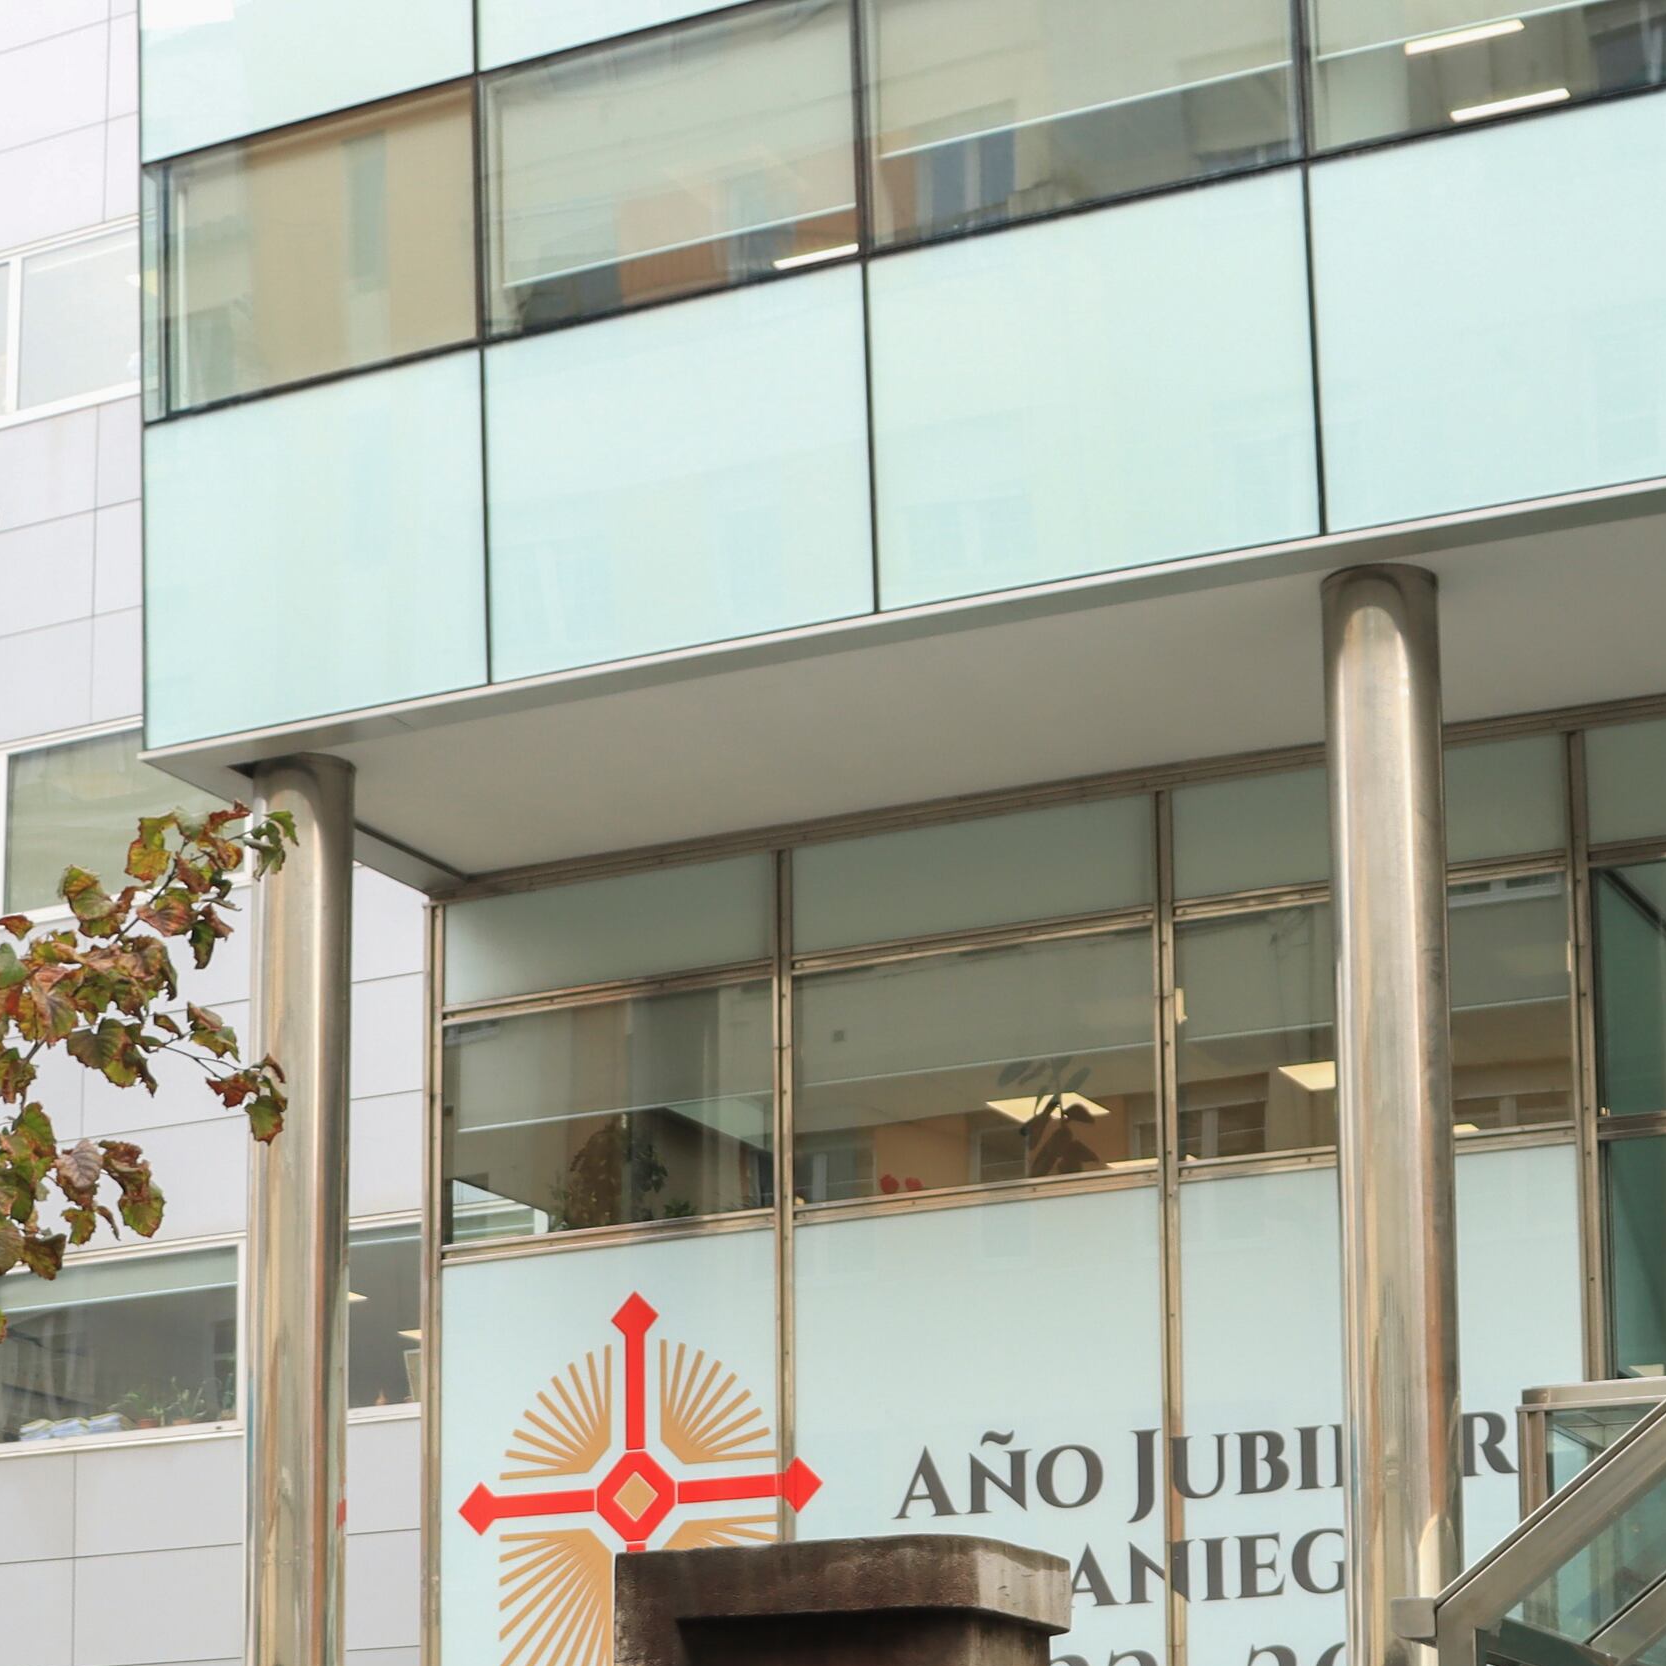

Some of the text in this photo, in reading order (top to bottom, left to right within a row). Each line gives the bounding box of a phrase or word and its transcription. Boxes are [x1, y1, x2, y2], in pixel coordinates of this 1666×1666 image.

[891, 1411, 1520, 1524] AÑO JUBIR
[1072, 1526, 1346, 1609] ANIEG
